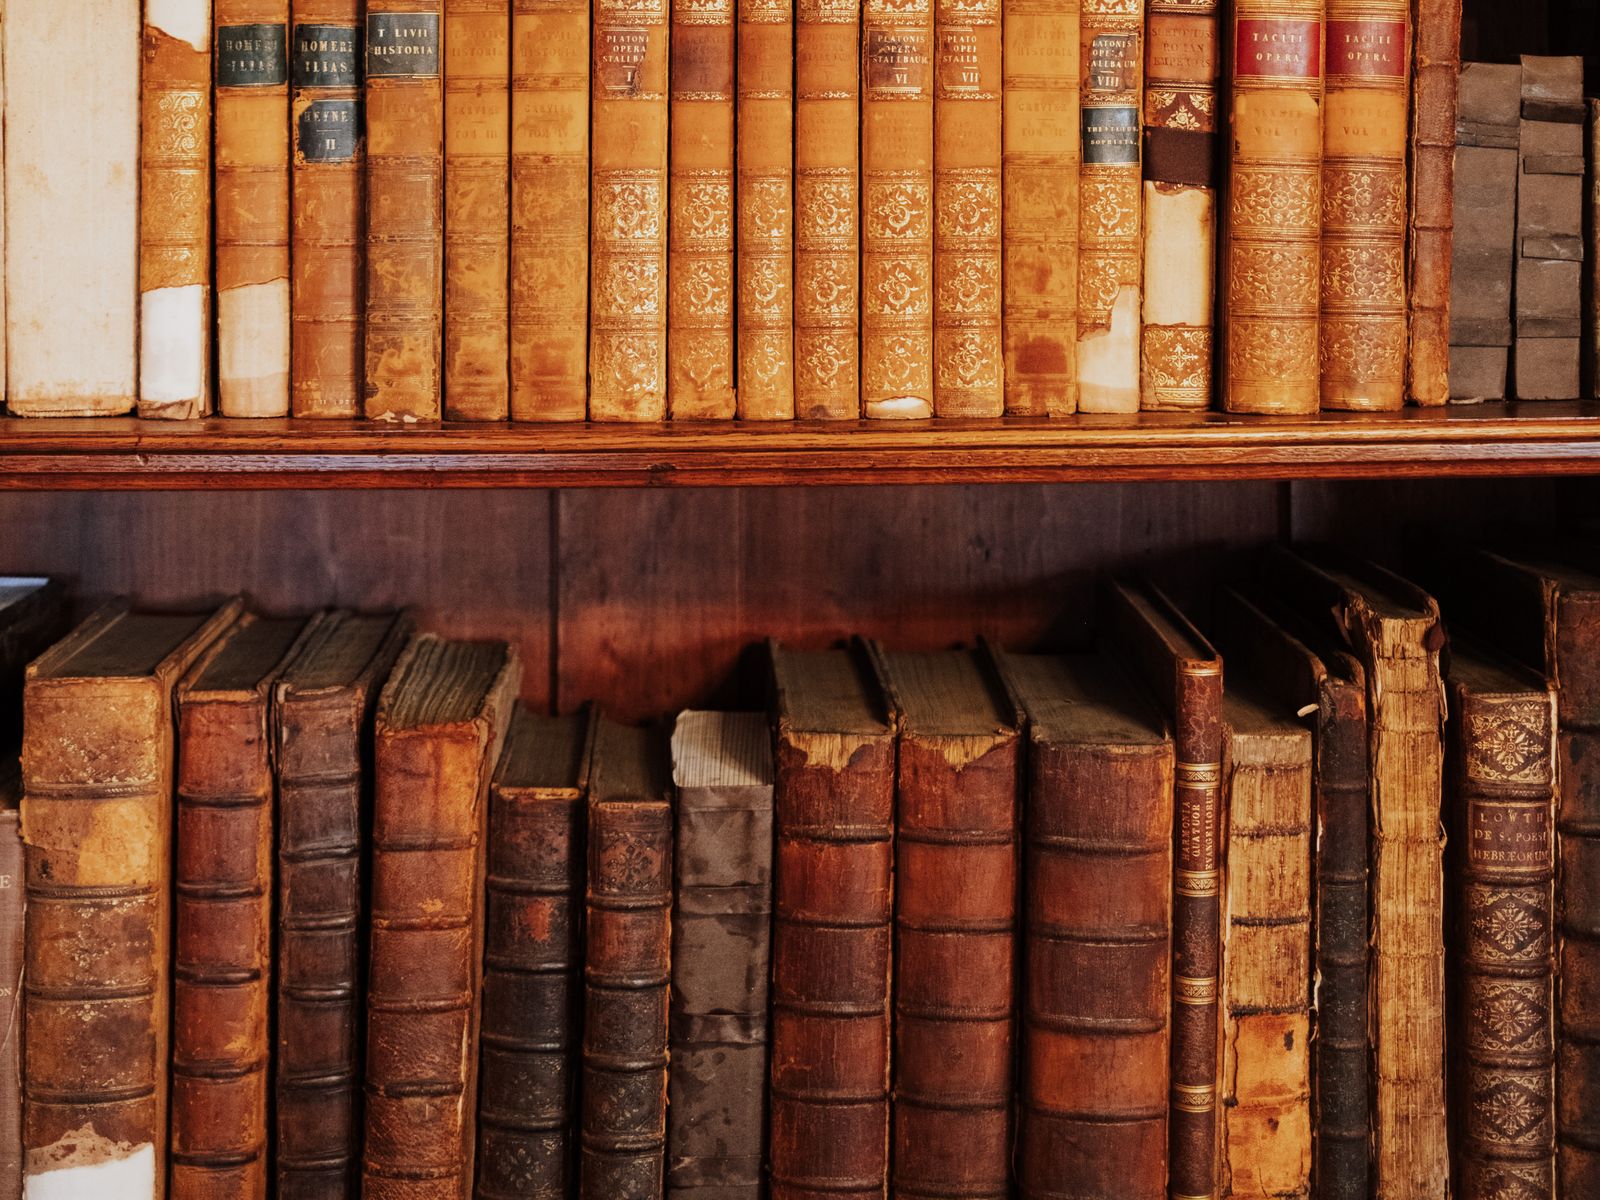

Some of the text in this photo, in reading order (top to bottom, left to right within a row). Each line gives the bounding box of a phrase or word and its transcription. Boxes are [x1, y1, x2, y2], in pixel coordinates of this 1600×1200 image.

[878, 35, 925, 43] PLATONIS
[1253, 33, 1303, 43] TACITI
[1345, 34, 1391, 45] TACITI
[374, 46, 433, 56] HISTORIA
[1480, 812, 1543, 824] LOWTH
[1192, 804, 1200, 858] QUATUOR
[1474, 829, 1492, 840] DE
